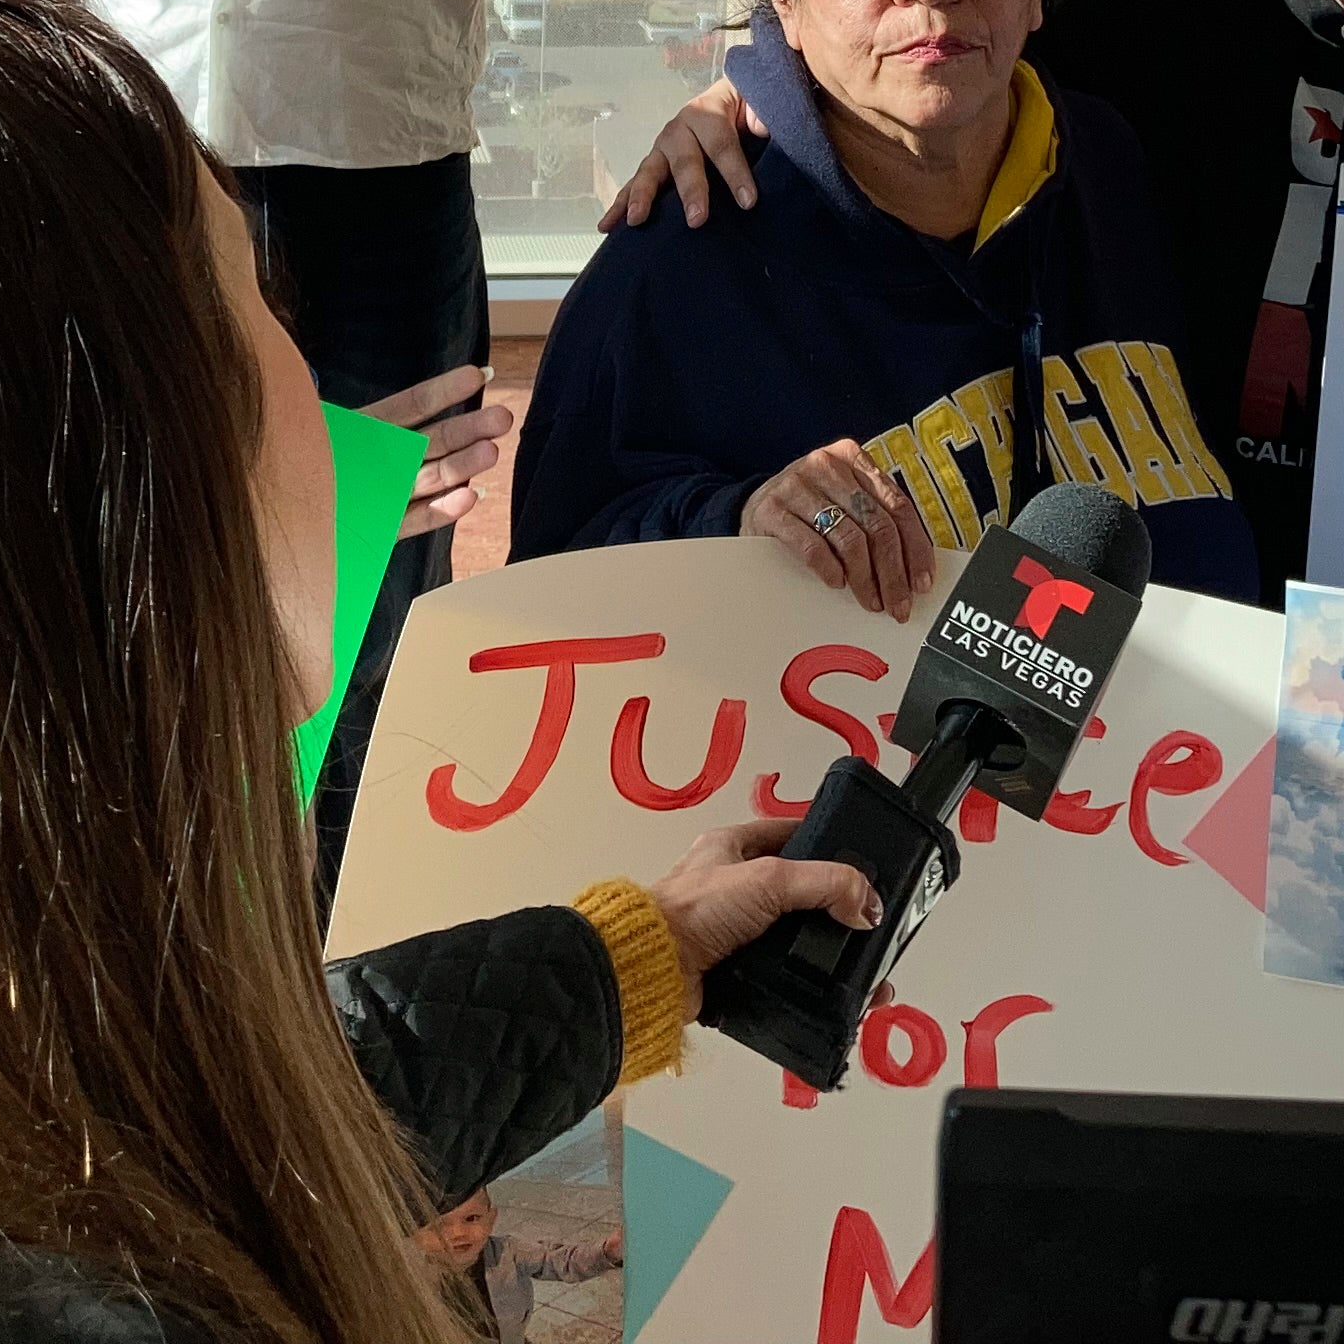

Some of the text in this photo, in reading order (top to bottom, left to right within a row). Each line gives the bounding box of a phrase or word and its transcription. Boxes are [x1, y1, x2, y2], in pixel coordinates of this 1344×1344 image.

[1236, 436, 1304, 468] CALI
[939, 620, 1085, 708] LAS VEGAS
[950, 600, 1094, 689] NOTICIERO
[782, 994, 1054, 1109] or
